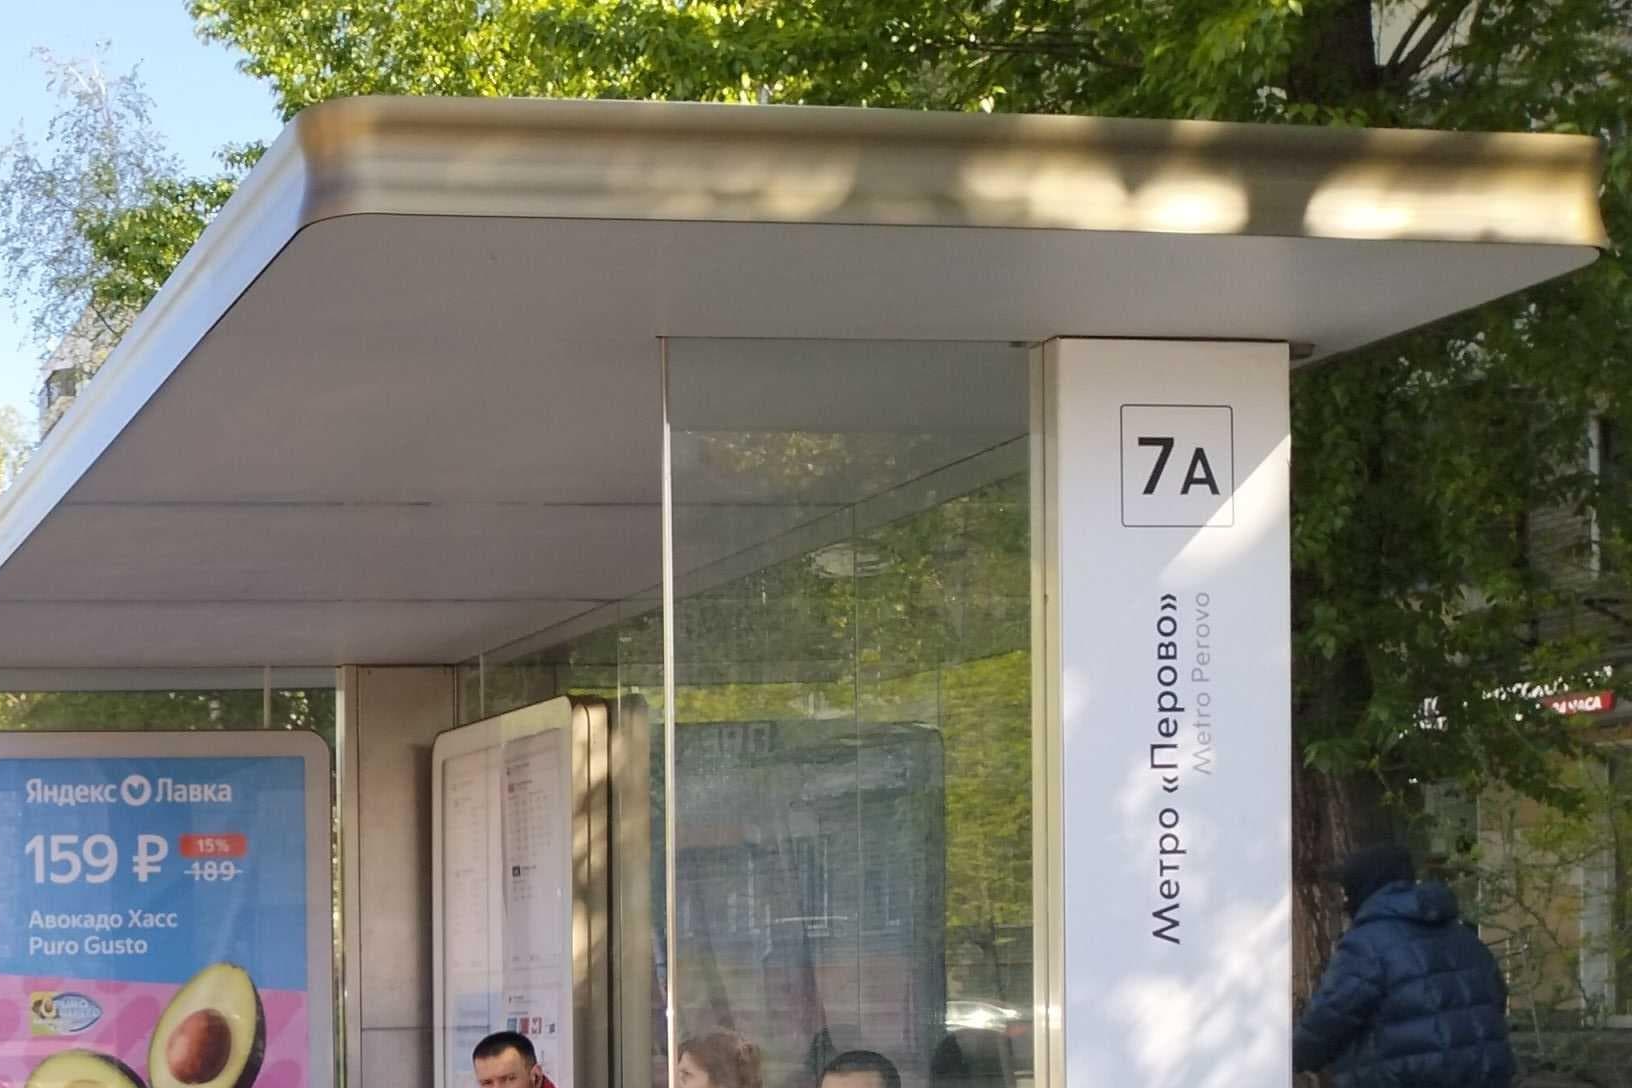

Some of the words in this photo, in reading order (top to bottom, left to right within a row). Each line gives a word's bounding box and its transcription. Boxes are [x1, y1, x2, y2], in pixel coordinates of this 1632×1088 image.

[1191, 592, 1211, 682] Perovo
[1150, 592, 1185, 794] «Перово»
[1192, 691, 1212, 776] Metro
[25, 778, 117, 806] Яндекс
[155, 777, 233, 803] Лавка
[24, 834, 118, 884] 159
[196, 838, 230, 853] 15%
[191, 861, 236, 881] 189
[1151, 807, 1187, 945] Метро
[28, 910, 122, 932] Авокадо
[127, 909, 178, 929] Хасс
[28, 936, 79, 956] Puro
[83, 936, 149, 955] Gusto
